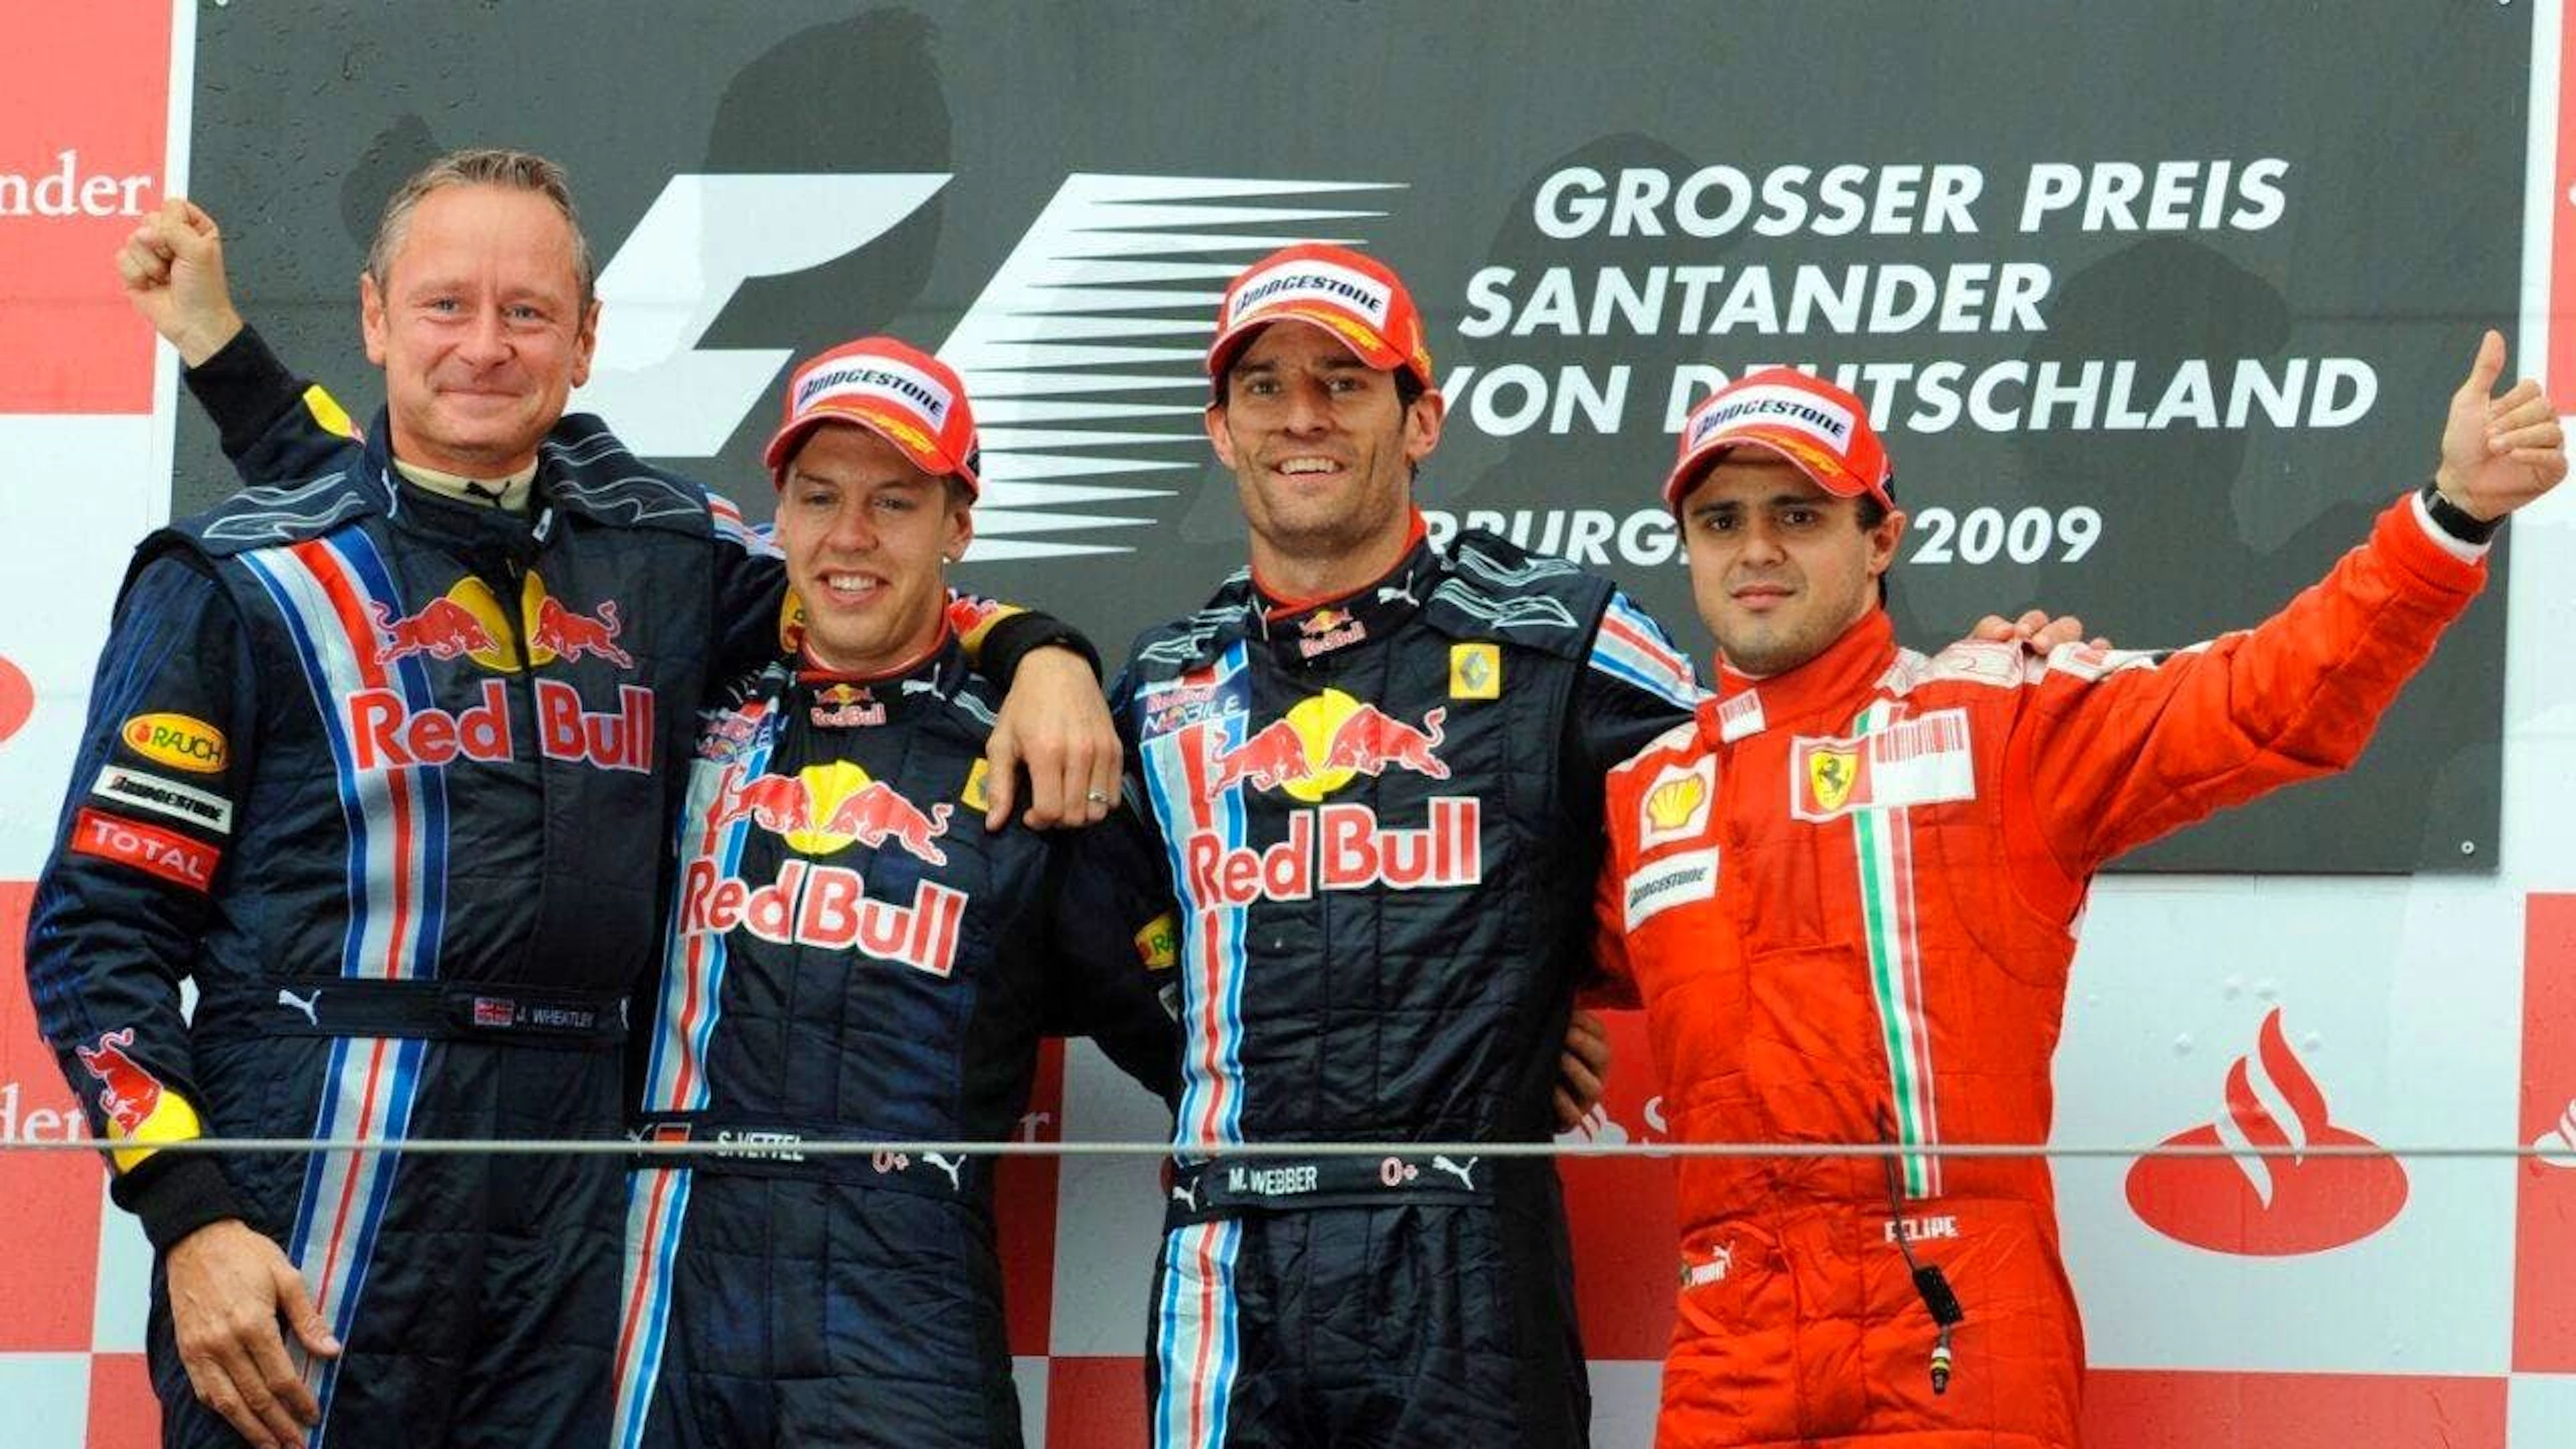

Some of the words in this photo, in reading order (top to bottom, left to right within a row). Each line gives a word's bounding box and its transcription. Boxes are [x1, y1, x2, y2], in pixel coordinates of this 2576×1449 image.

[1534, 164, 1984, 239] GROSSER
[2019, 158, 2290, 232] PREIS
[1234, 274, 1383, 319] BRIDGESTONE
[1457, 262, 2053, 337] SANTANDER
[796, 368, 947, 419] BRIDGESTONE
[1664, 357, 2379, 435] DTSCHLAND
[1690, 398, 1848, 447] BRIDGESTONE
[1909, 506, 2104, 565] 2009
[152, 724, 223, 765] RAUCH
[347, 678, 515, 773] Red
[534, 678, 654, 775] Bull
[90, 818, 205, 880] TOTAL
[1185, 809, 1315, 914] Red
[1318, 796, 1482, 891] Bull
[677, 858, 809, 945] Red
[794, 864, 969, 978] Bull
[1250, 1166, 1318, 1195] WEBBER
